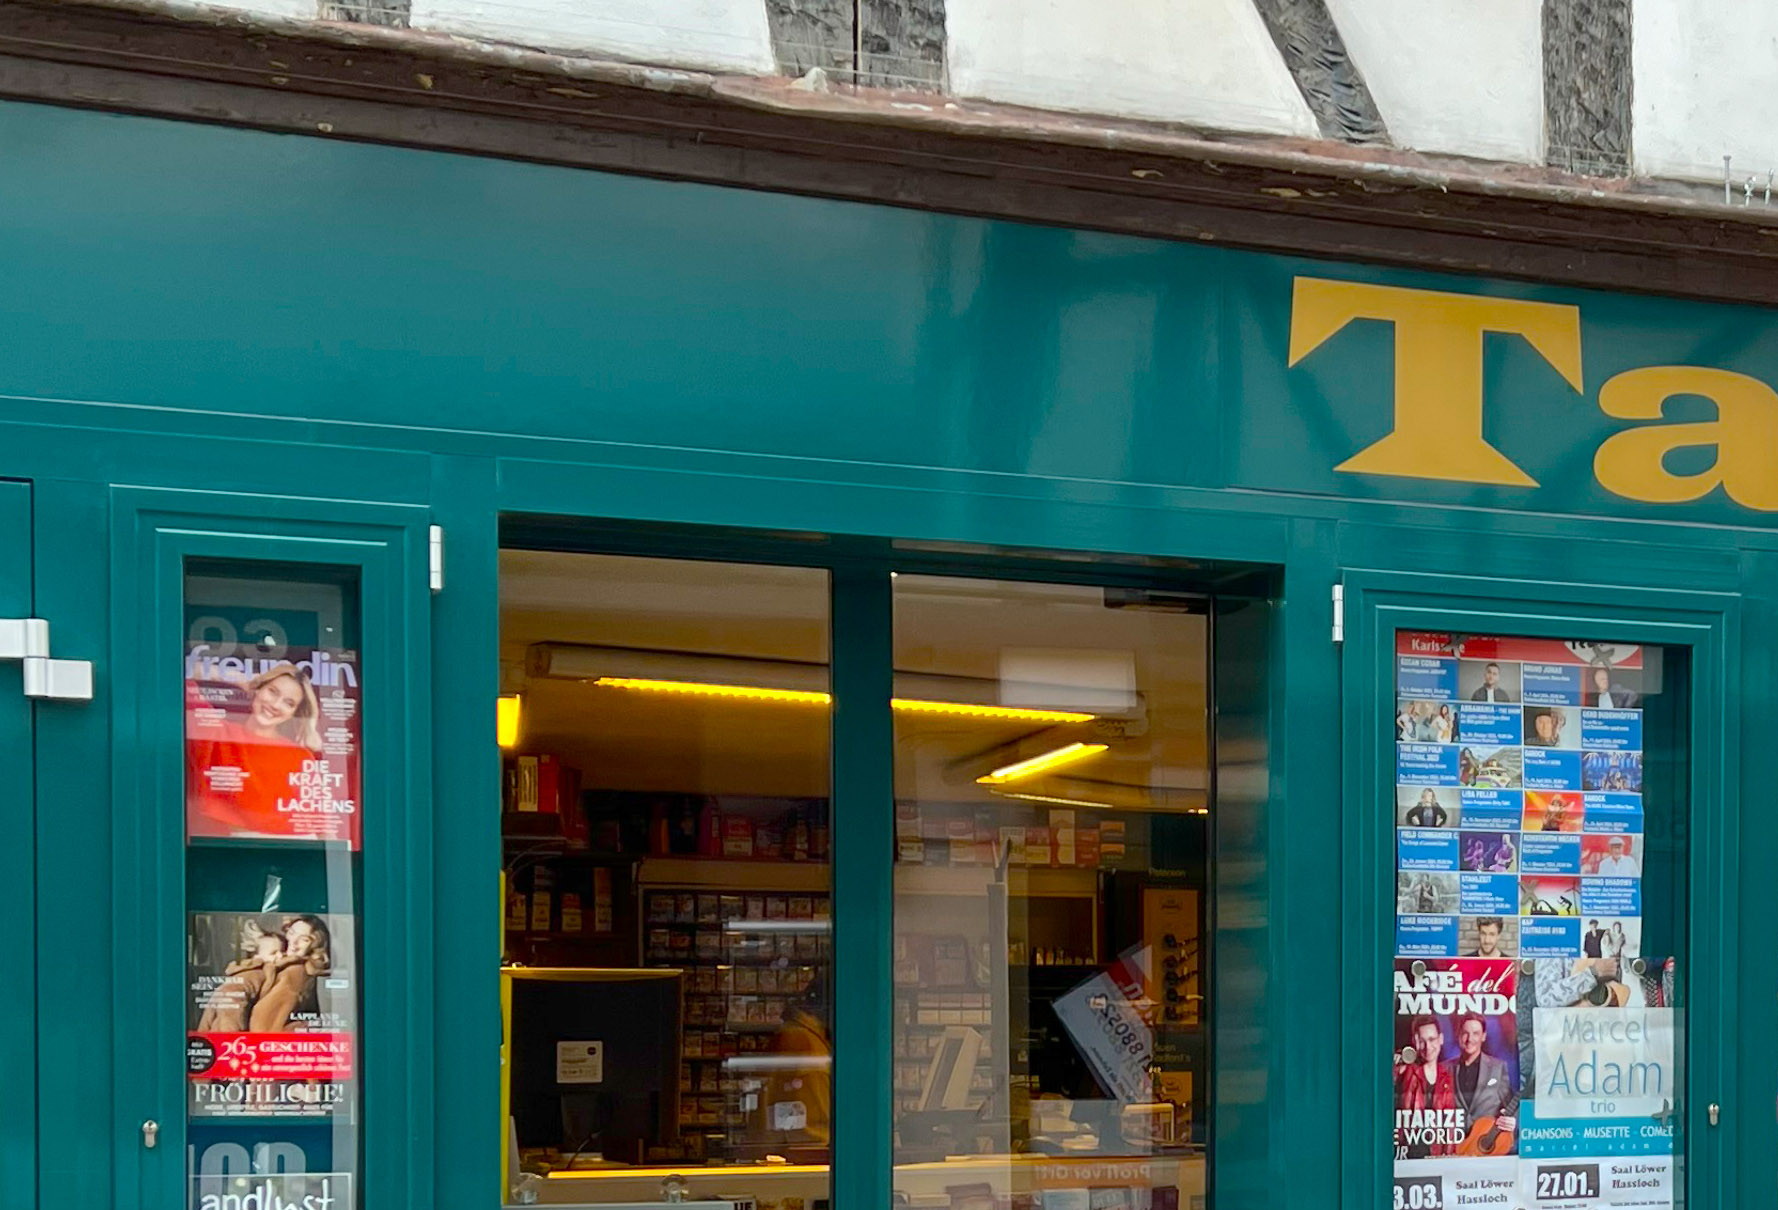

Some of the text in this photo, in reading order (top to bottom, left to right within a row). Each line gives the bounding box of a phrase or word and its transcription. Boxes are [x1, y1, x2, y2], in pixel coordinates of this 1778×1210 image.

[302, 760, 329, 773] DIE
[288, 772, 344, 787] KRAFT
[300, 786, 332, 800] DES
[277, 798, 355, 814] LACHENS
[1466, 962, 1514, 993] del
[1561, 1014, 1649, 1044] Marcel
[217, 1036, 257, 1064] 265
[259, 1041, 350, 1053] GESCHENKE
[1547, 1050, 1662, 1096] Adam
[194, 1082, 344, 1103] FRÖHLICHE!
[1590, 1100, 1616, 1114] trio
[1395, 1109, 1465, 1129] ITARIZE
[1404, 1128, 1465, 1145] WORLD
[1521, 1128, 1573, 1140] CHANSONS
[1583, 1126, 1630, 1139] MUSETTE
[1611, 1164, 1667, 1175] Saal Löwer
[1456, 1179, 1514, 1190] Saal Löwer
[1537, 1171, 1594, 1197] 27.01.
[1612, 1178, 1660, 1189] Hassloch
[1457, 1193, 1508, 1205] Hassloch
